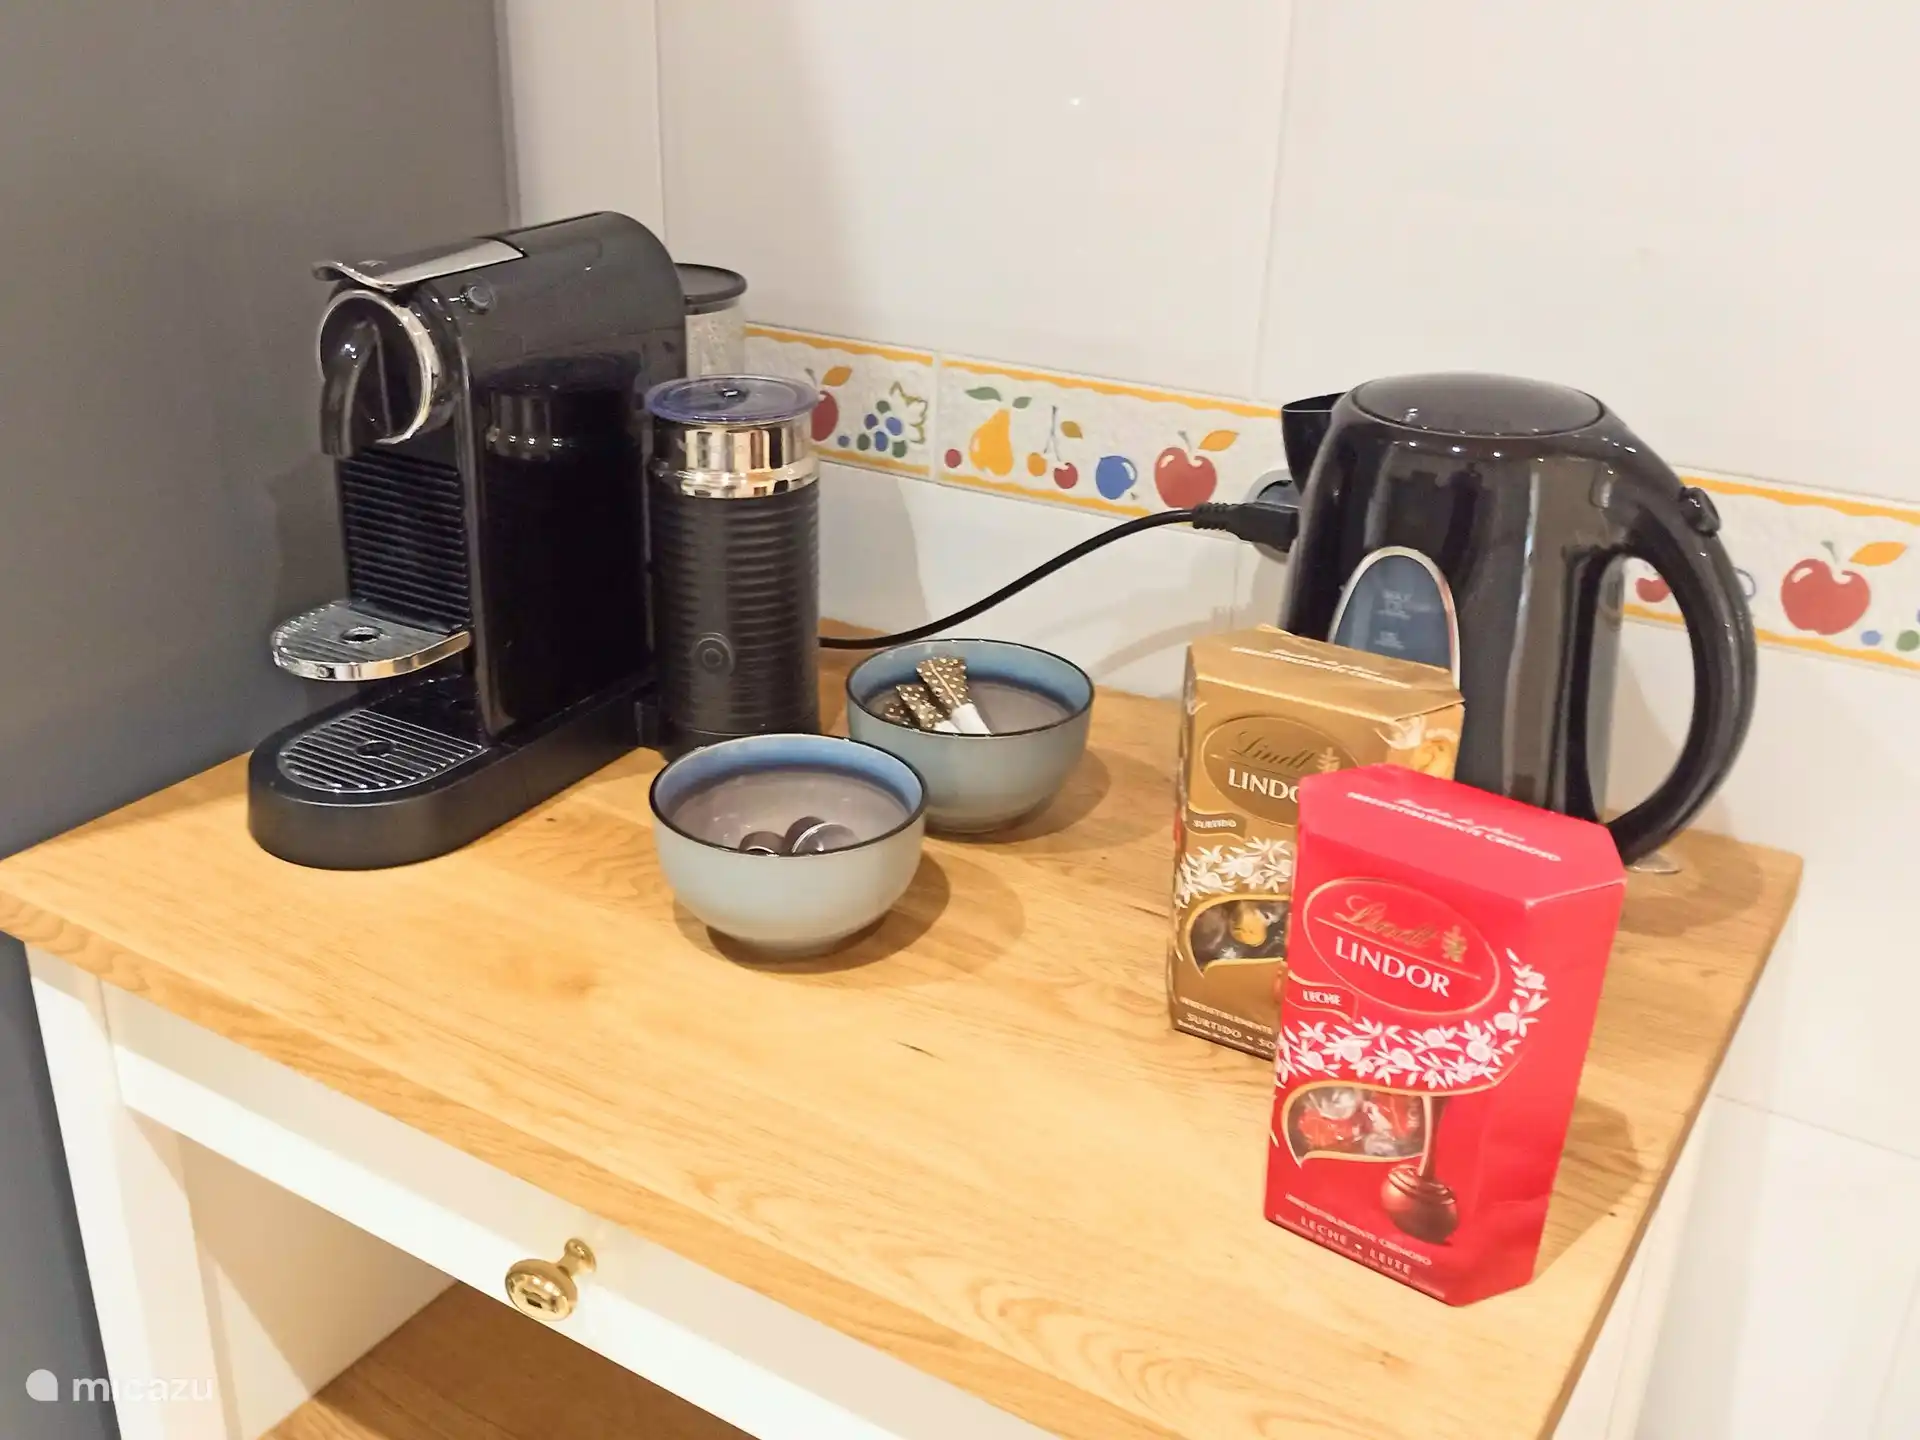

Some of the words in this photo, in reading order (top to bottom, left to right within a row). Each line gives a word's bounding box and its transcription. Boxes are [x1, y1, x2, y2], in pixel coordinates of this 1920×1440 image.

[1228, 767, 1300, 804] LIND
[1333, 894, 1438, 948] Lindt
[1335, 935, 1450, 998] LINDOR
[1302, 989, 1342, 1006] LECHE
[1186, 1012, 1242, 1039] SURTIDO
[1300, 1215, 1348, 1246] LECHE
[1368, 1247, 1412, 1276] LEITE
